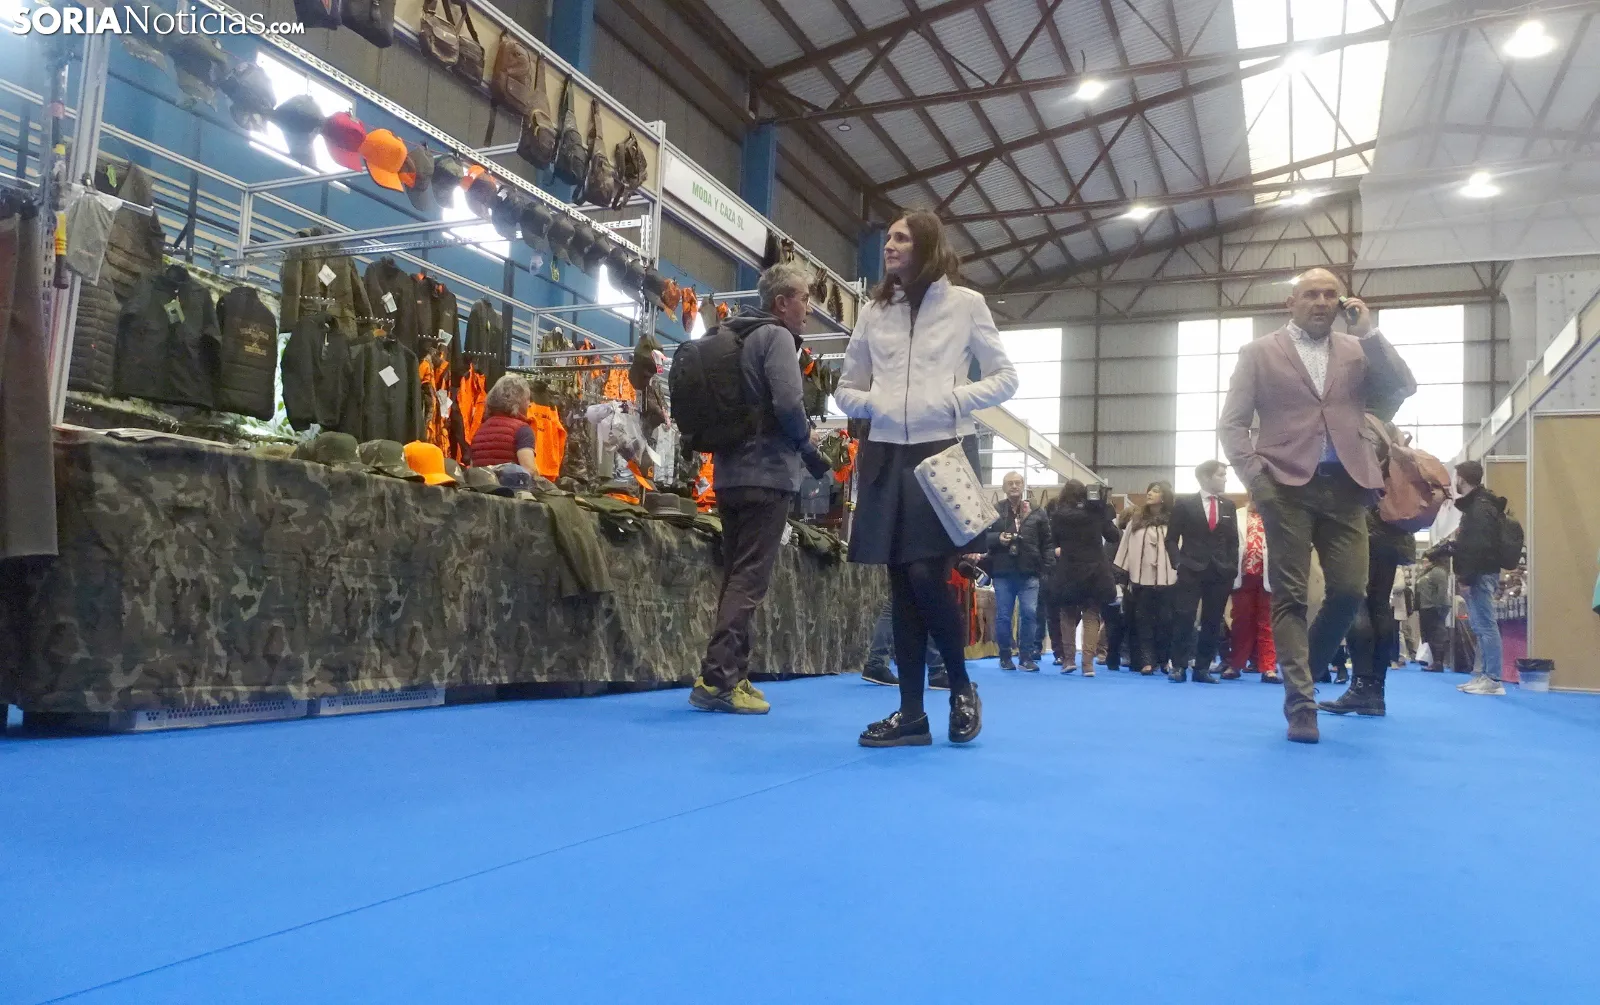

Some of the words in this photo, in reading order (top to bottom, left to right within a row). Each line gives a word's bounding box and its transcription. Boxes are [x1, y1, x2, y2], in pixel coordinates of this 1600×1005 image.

[692, 181, 712, 207] MODA
[714, 197, 719, 211] Y
[720, 202, 736, 225] CAZA
[737, 215, 744, 231] SL
